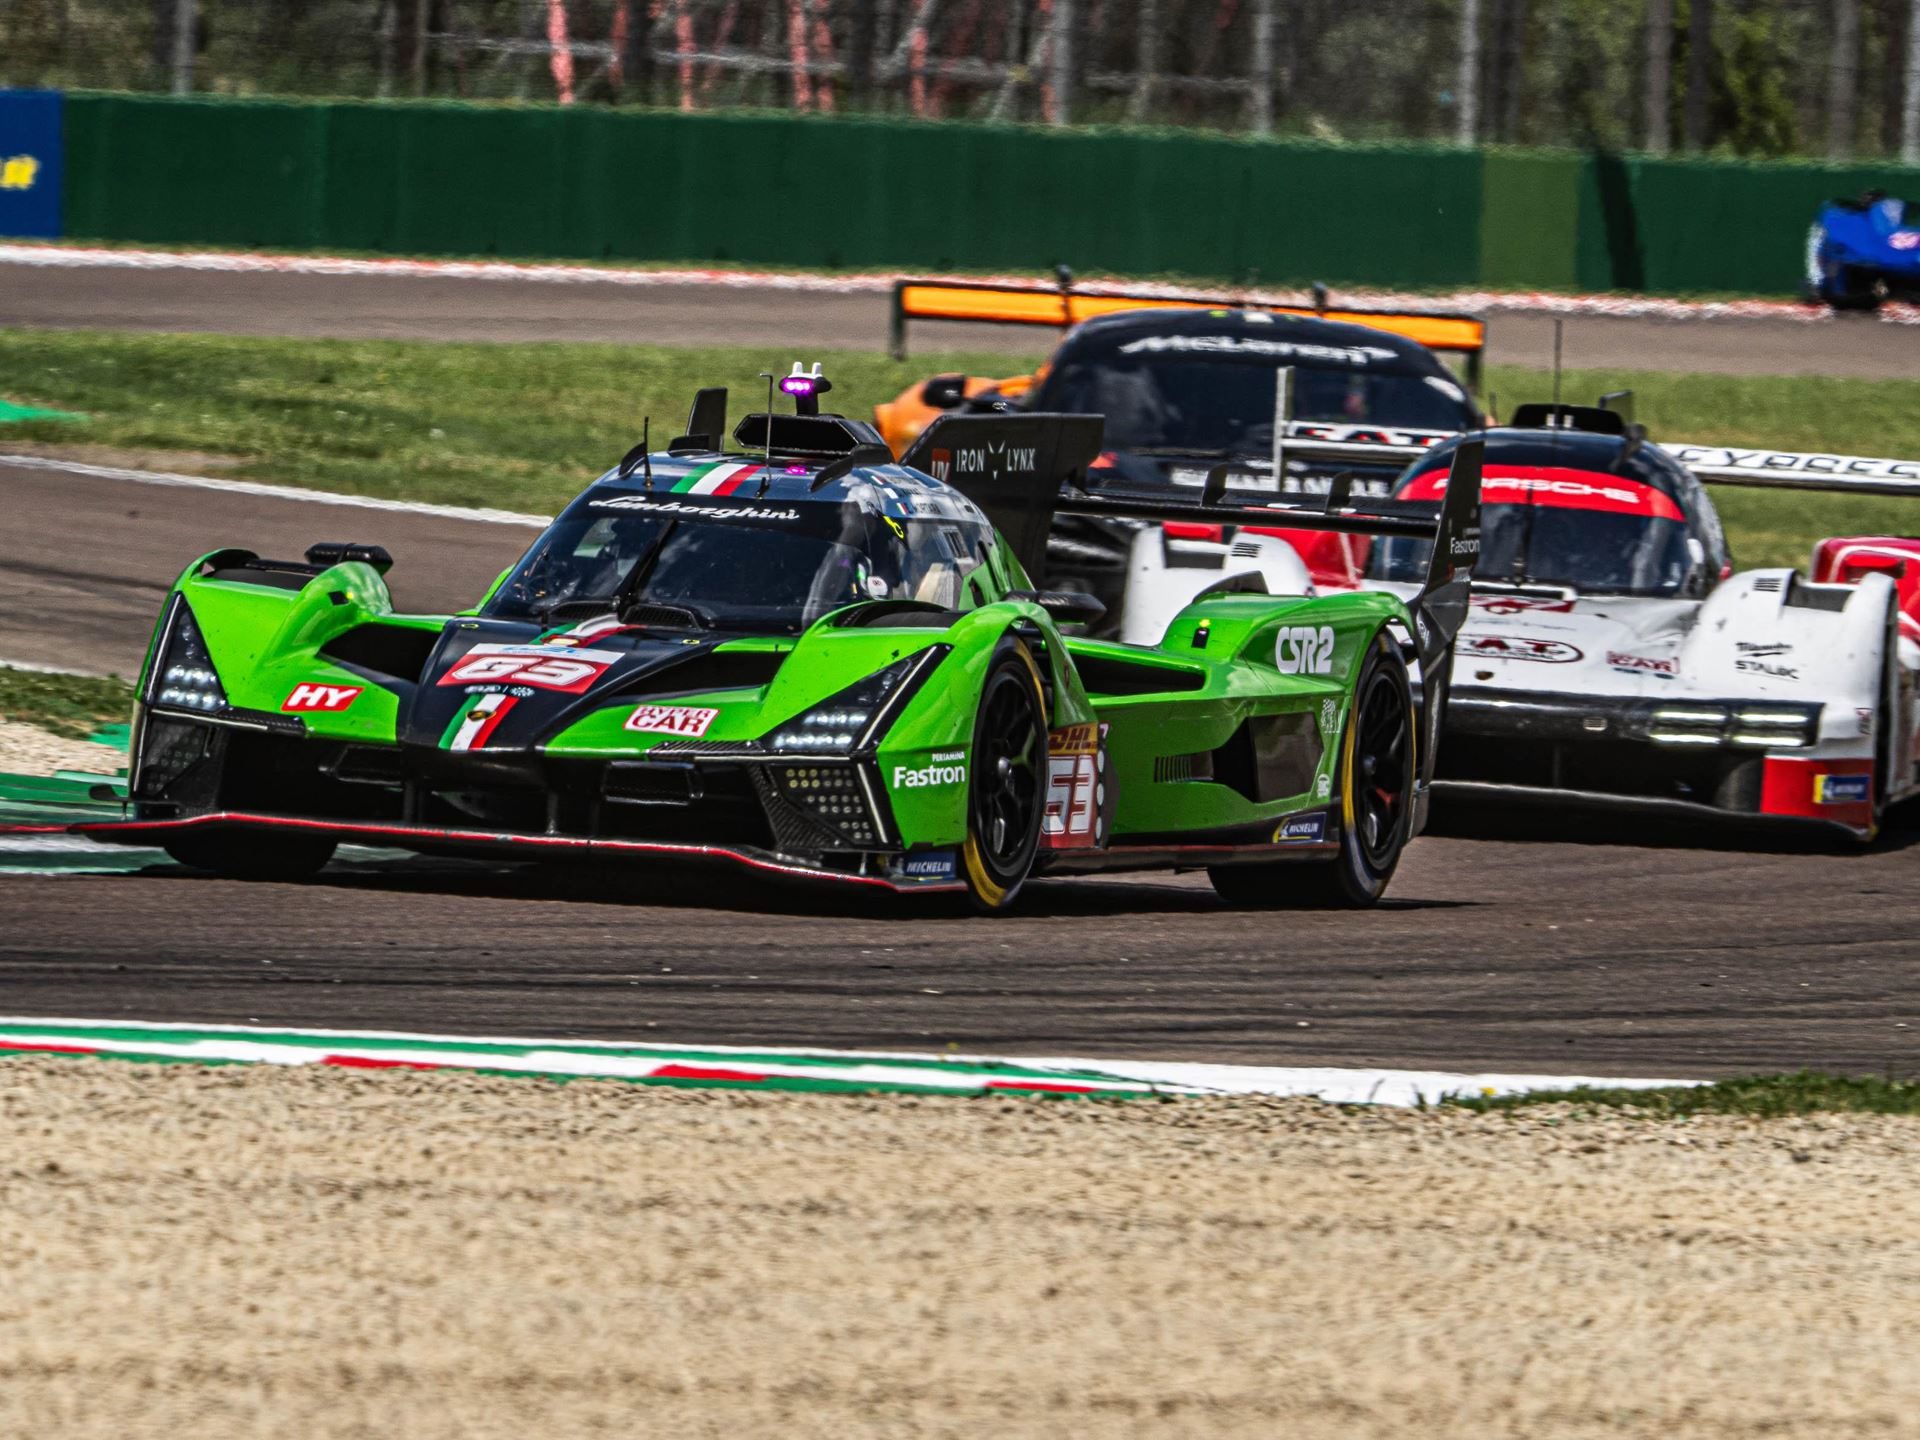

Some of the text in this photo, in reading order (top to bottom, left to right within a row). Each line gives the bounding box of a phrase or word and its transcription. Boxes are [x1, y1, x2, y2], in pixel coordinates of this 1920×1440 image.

[956, 448, 984, 472] IRON
[1007, 447, 1036, 472] LYNX
[1433, 477, 1640, 504] PRSCHE
[588, 495, 800, 521] Lamborghini
[1275, 626, 1335, 674] CSR2
[287, 685, 358, 707] HY
[631, 714, 705, 732] CAR
[1048, 725, 1094, 750] DHL
[893, 764, 966, 789] Fastron
[906, 861, 952, 873] MICHELIN
